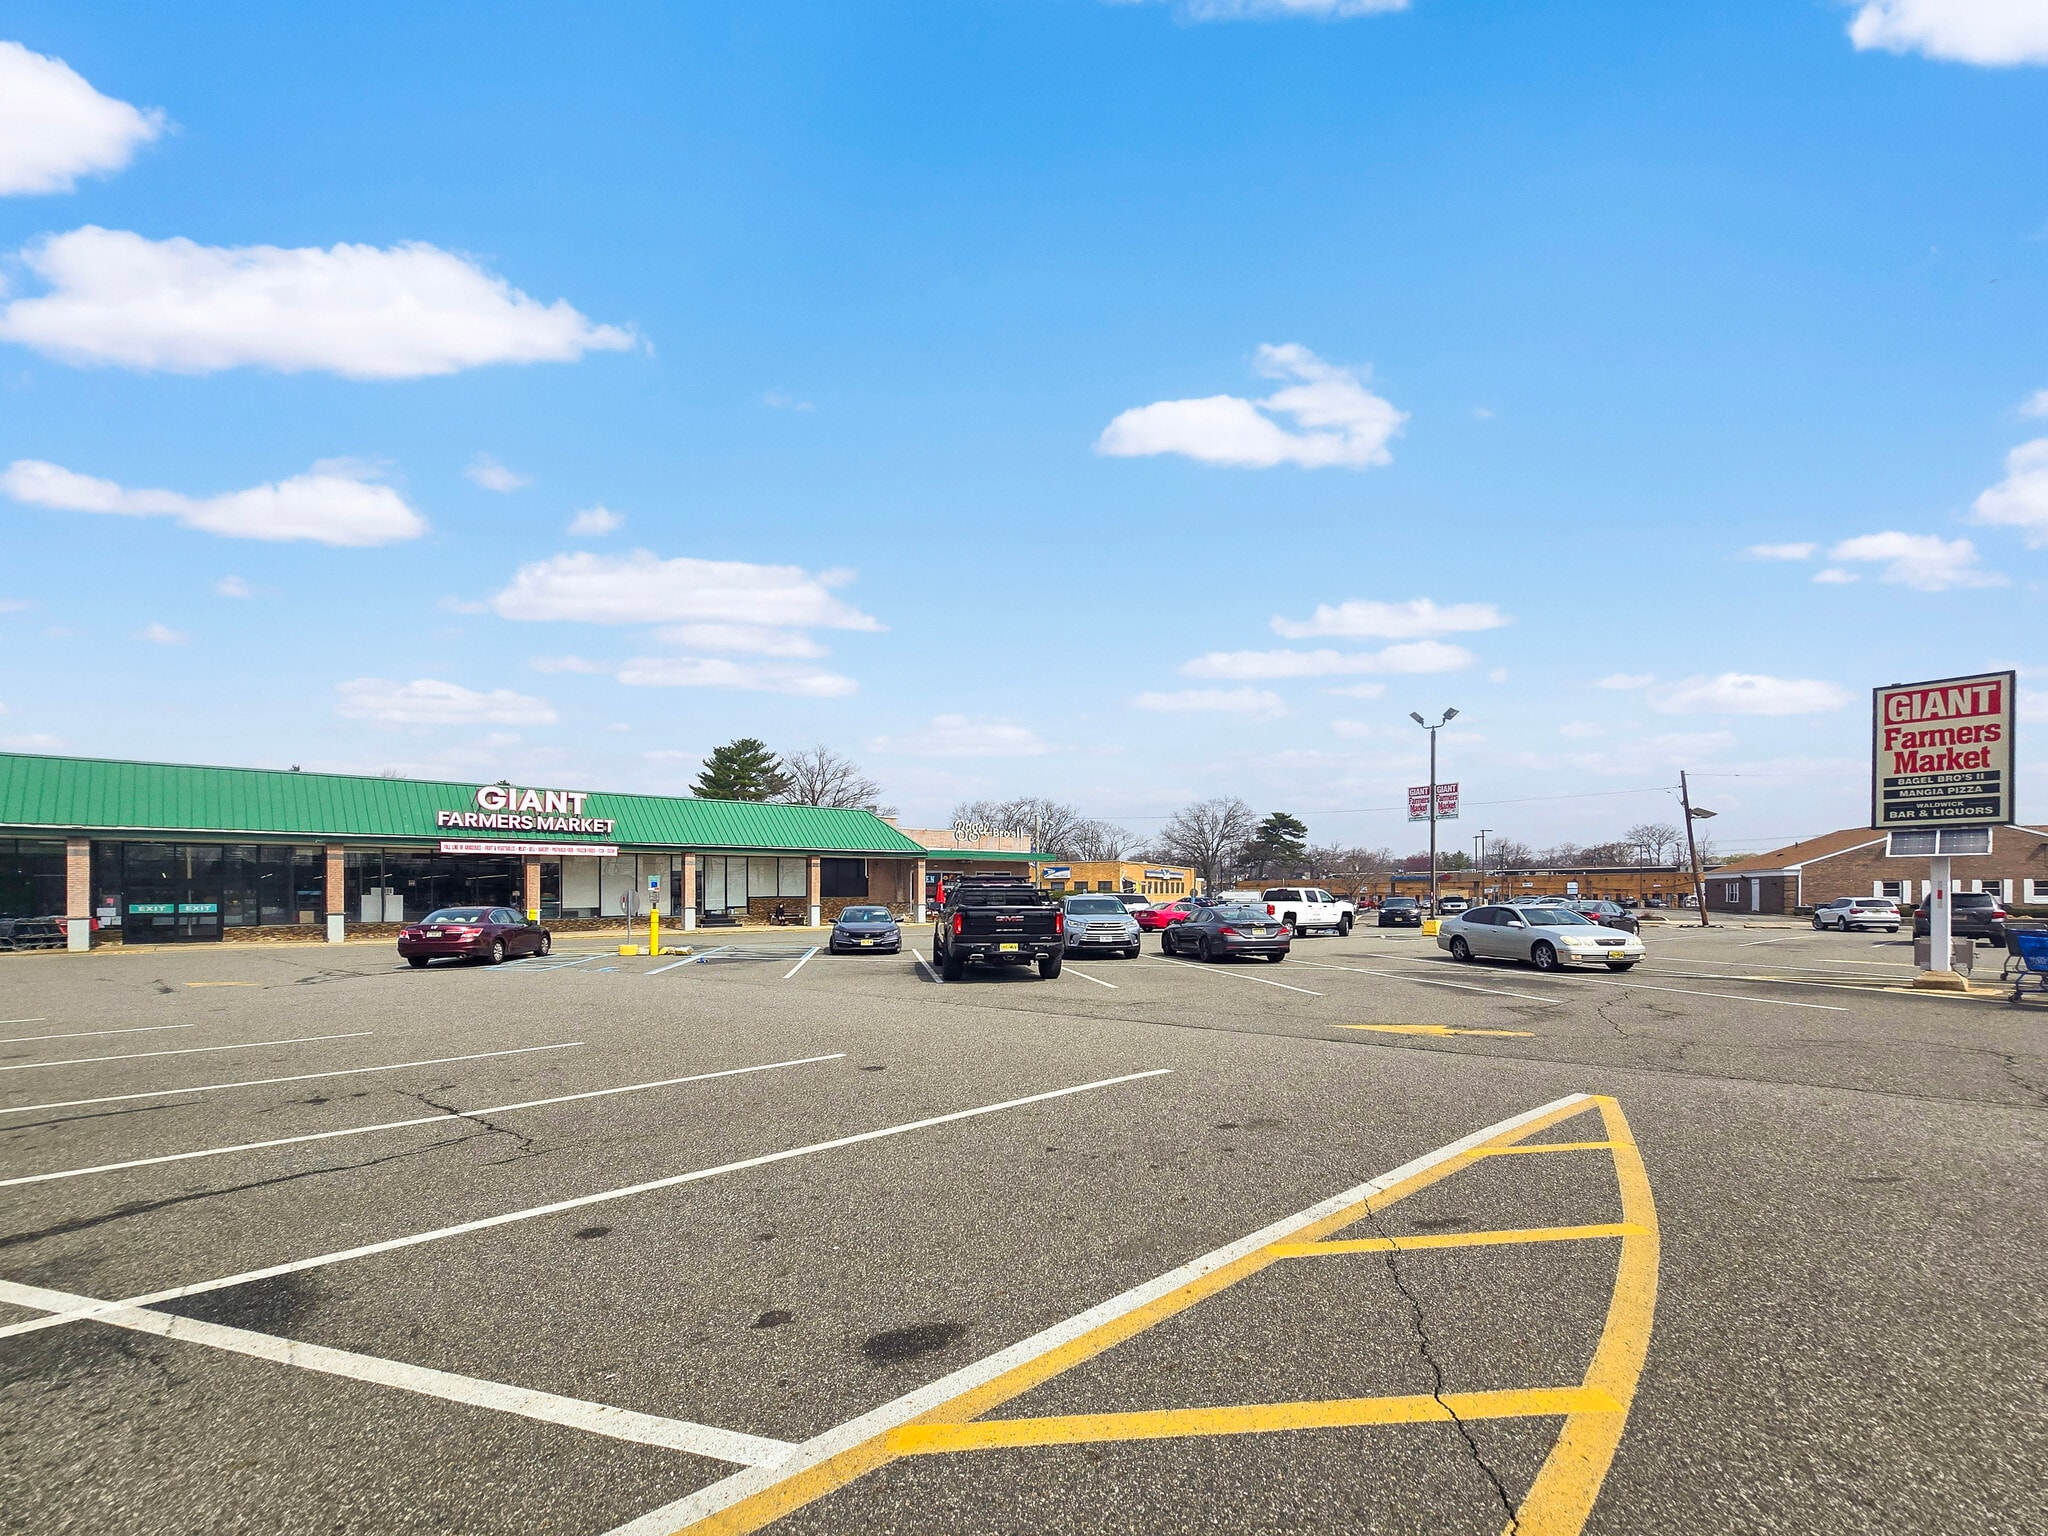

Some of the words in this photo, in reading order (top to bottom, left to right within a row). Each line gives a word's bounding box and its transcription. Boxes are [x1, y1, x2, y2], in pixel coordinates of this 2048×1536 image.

[1888, 684, 1997, 722] GIANT
[1884, 723, 2001, 751] Farmers
[1893, 746, 1991, 774] Market
[1898, 776, 1934, 785] BAGEL
[1937, 774, 1973, 783] BRO'S
[1410, 787, 1429, 796] GIANT
[1437, 785, 1457, 794] GIANT
[1899, 788, 1944, 797] MANGIA
[1947, 785, 1983, 794] PIZZA
[477, 785, 588, 815] GIANT
[1409, 797, 1430, 805] Farmers
[1436, 794, 1458, 802] Farmers
[1410, 804, 1428, 812] Market
[1437, 801, 1456, 810] Market
[1916, 801, 1964, 809] WALDWICK
[1889, 811, 1915, 819] BAR
[1933, 806, 1994, 817] LIQUORS
[437, 811, 533, 830] FARMERS
[536, 817, 616, 833] MARKET
[954, 819, 990, 842] Bagel
